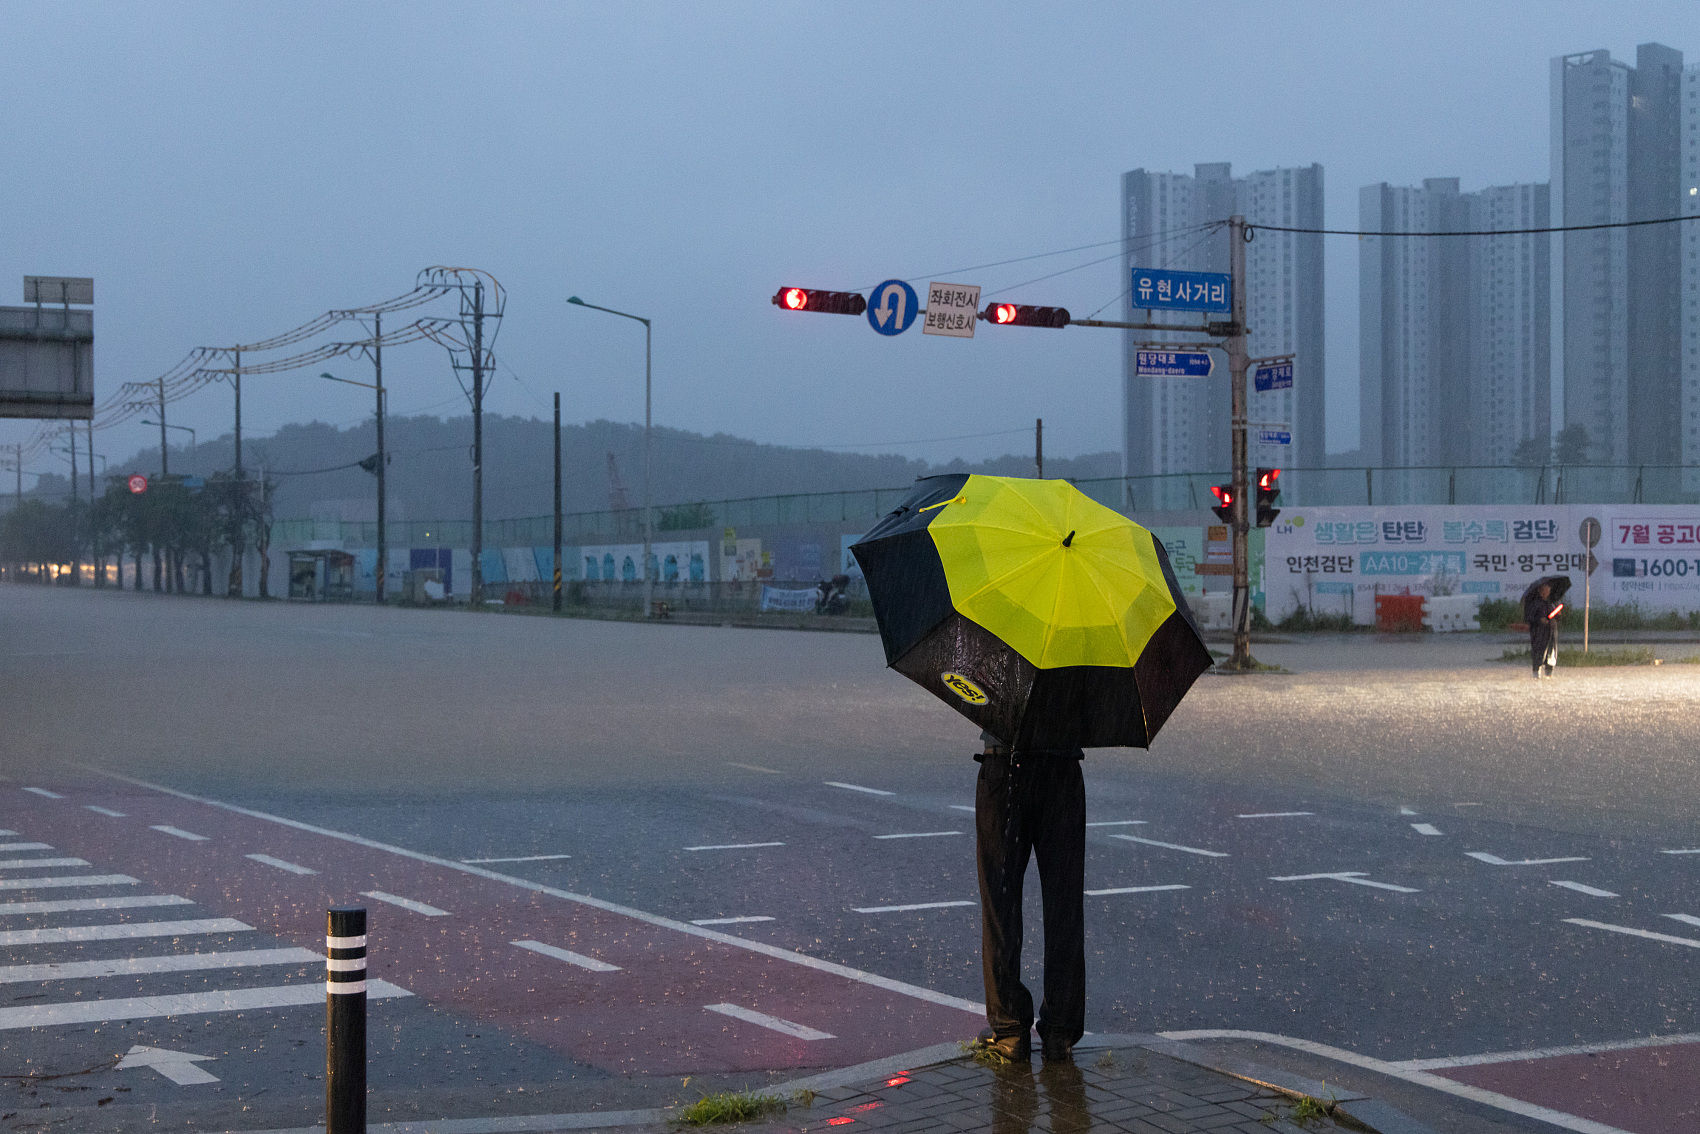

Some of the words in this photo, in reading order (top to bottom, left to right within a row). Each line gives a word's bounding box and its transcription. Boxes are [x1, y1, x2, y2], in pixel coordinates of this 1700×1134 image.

[930, 289, 979, 310] 좌회전시
[1138, 278, 1225, 304] 유현사거리
[926, 312, 975, 332] 보행신호시
[1138, 352, 1177, 365] 원당대로
[1276, 525, 1293, 535] LH
[1314, 520, 1376, 543] 생활은
[1382, 520, 1425, 541] 탄탄
[1443, 519, 1506, 541] 볼수록
[1513, 519, 1557, 540] 검단
[1619, 524, 1650, 544] 7월
[1656, 524, 1700, 544] 공고
[1286, 555, 1355, 574] 인천검단
[946, 675, 986, 702] YES!
